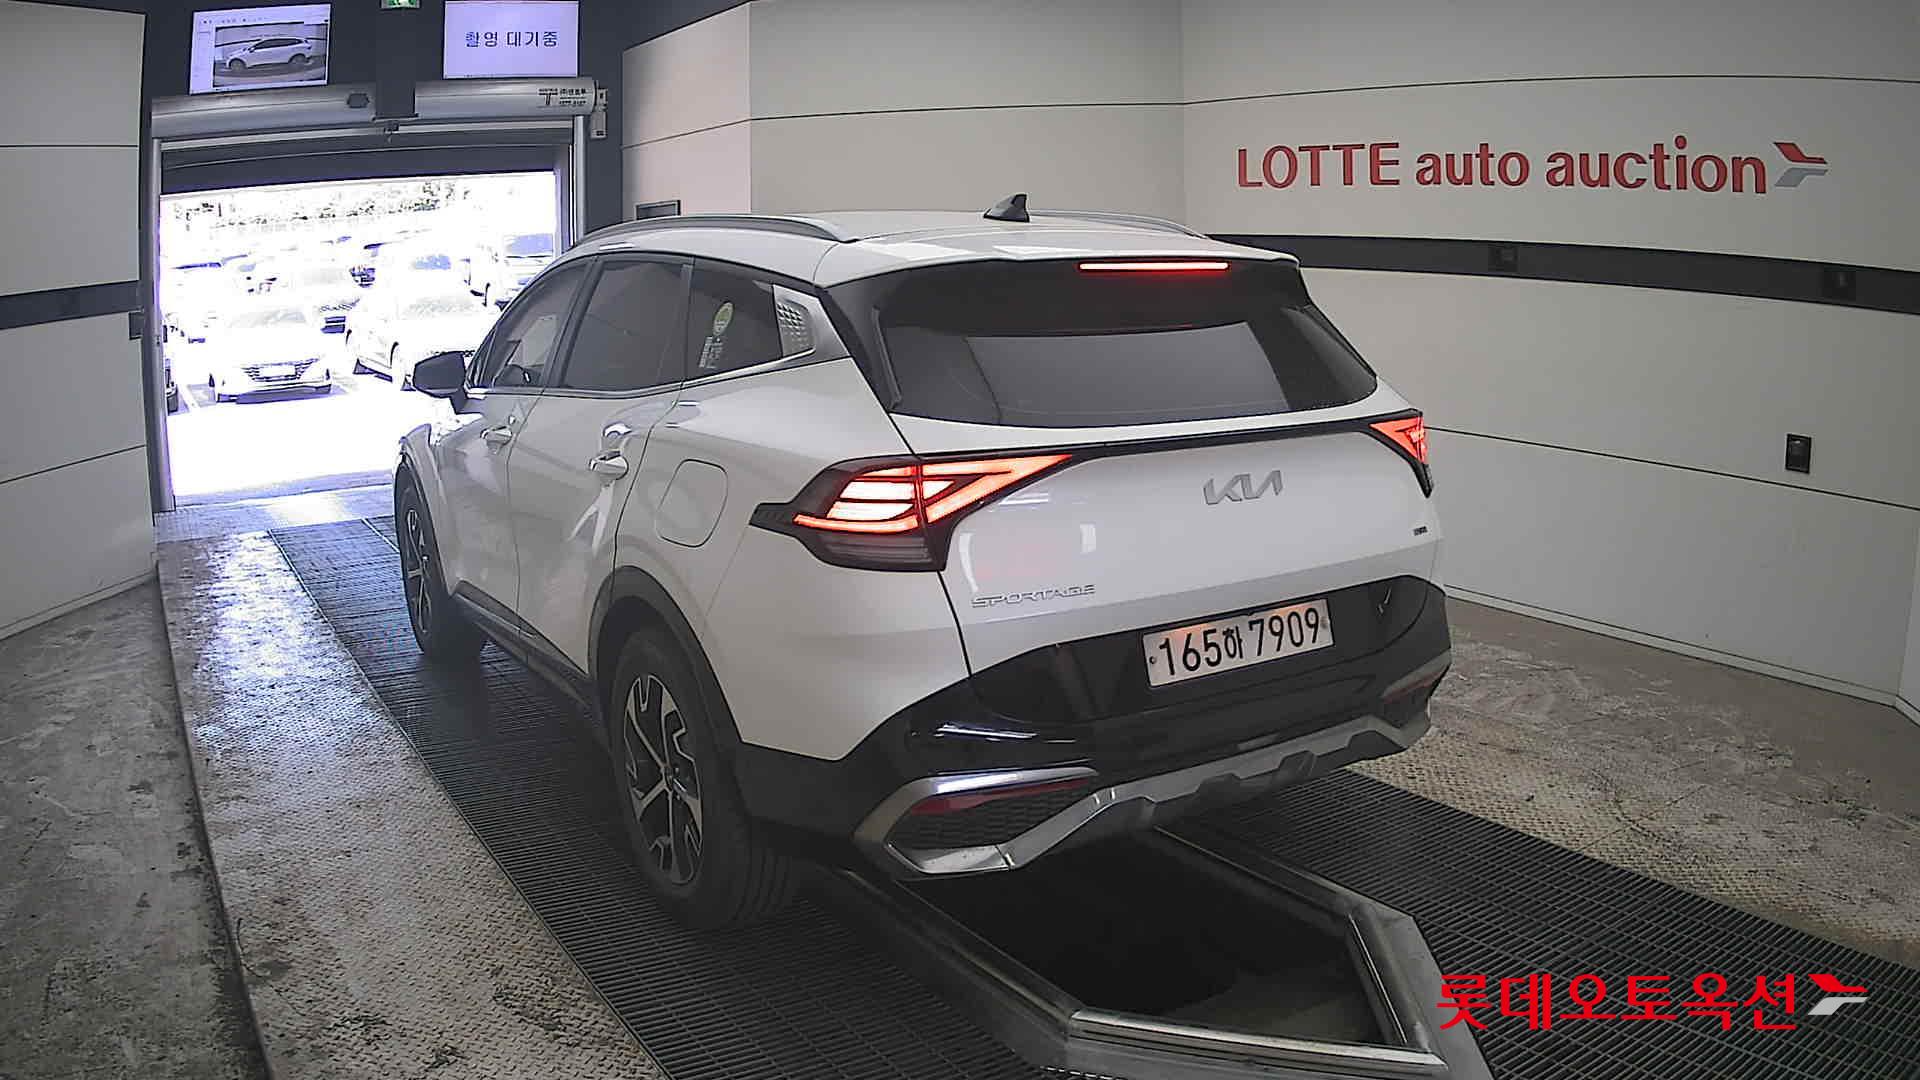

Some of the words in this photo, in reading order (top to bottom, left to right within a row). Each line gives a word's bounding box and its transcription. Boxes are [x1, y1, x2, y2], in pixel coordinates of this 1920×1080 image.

[506, 31, 559, 48] 대기중
[1238, 142, 1400, 188] LOTTE
[1416, 142, 1530, 187] auto
[1545, 135, 1767, 194] auction
[972, 584, 1096, 608] SPORTAGE
[1248, 607, 1319, 656] 7909
